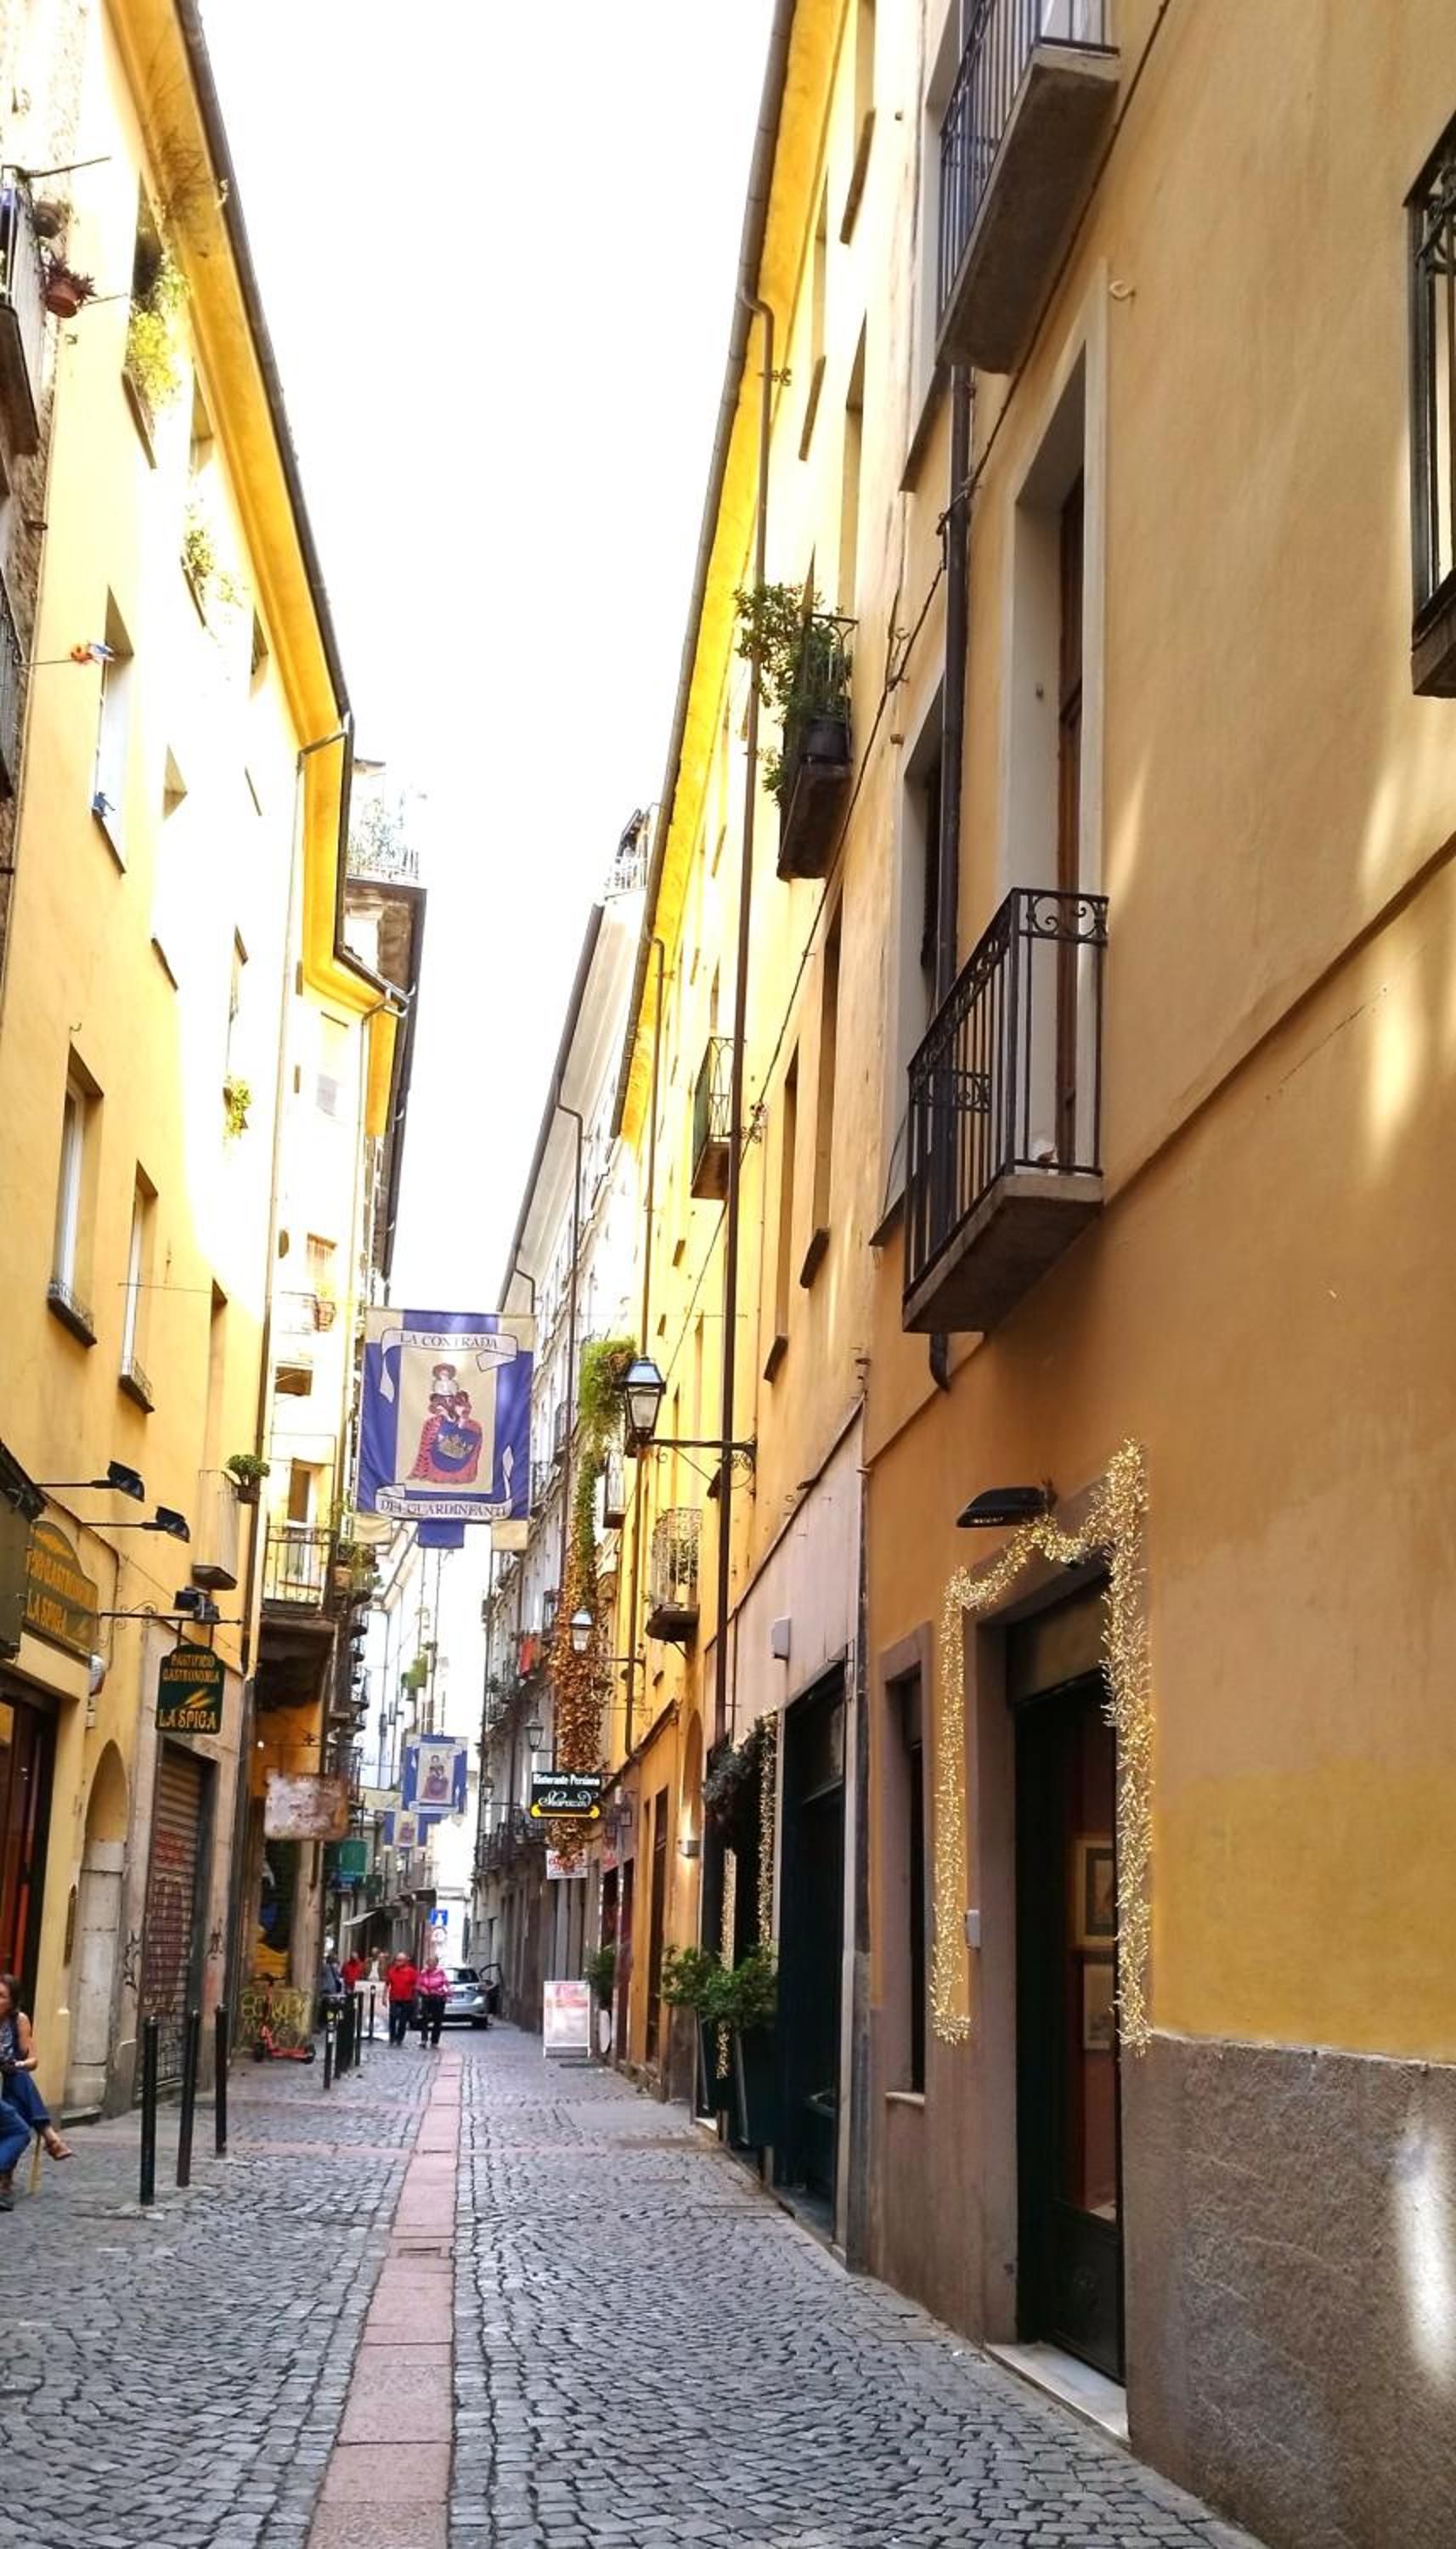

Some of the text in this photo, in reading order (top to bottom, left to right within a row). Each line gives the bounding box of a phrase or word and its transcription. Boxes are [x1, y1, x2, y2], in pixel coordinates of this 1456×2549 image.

[399, 1331, 498, 1349] LA CONTRADA
[158, 1708, 217, 1731] LA SPIGA
